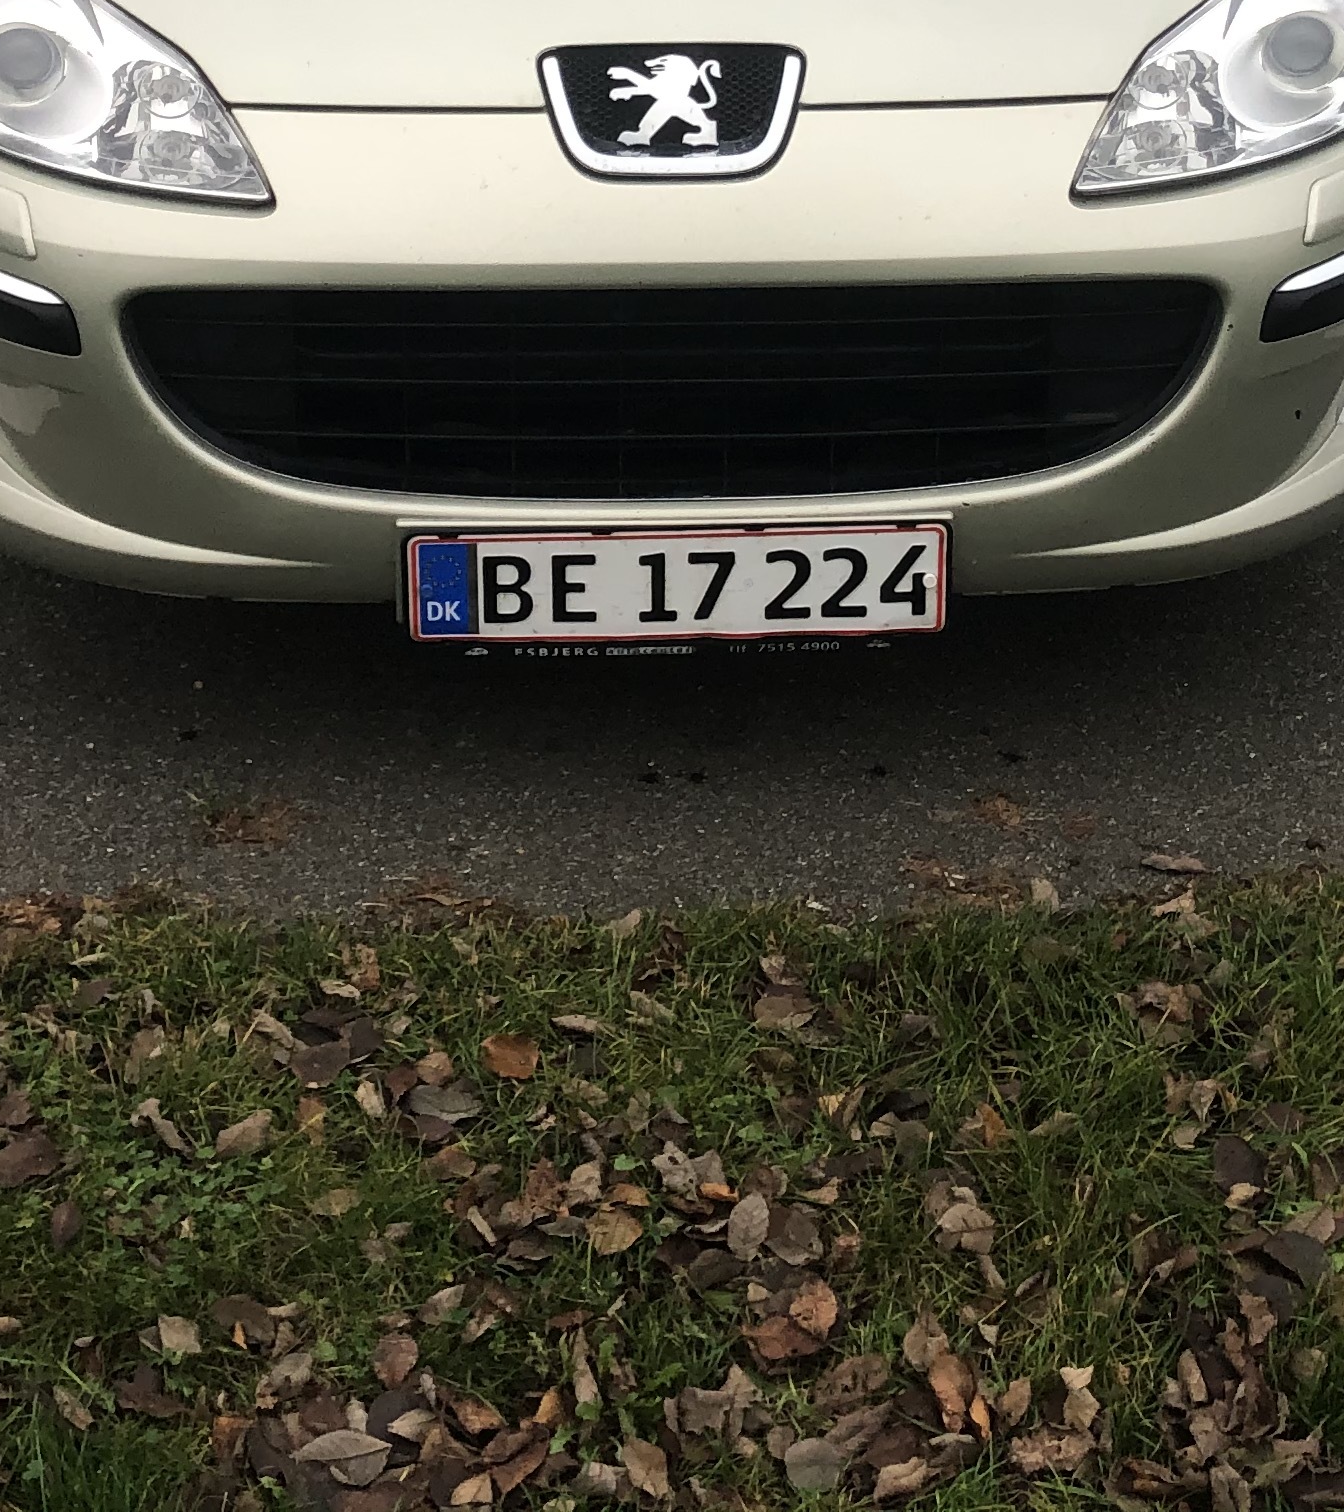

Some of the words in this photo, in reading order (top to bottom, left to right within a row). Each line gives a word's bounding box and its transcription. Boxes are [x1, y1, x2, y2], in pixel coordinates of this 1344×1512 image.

[482, 554, 598, 624] BE
[638, 551, 736, 623] 17
[764, 544, 927, 620] 224
[427, 600, 460, 621] DK
[758, 642, 796, 653] 7515
[800, 641, 840, 652] 4900
